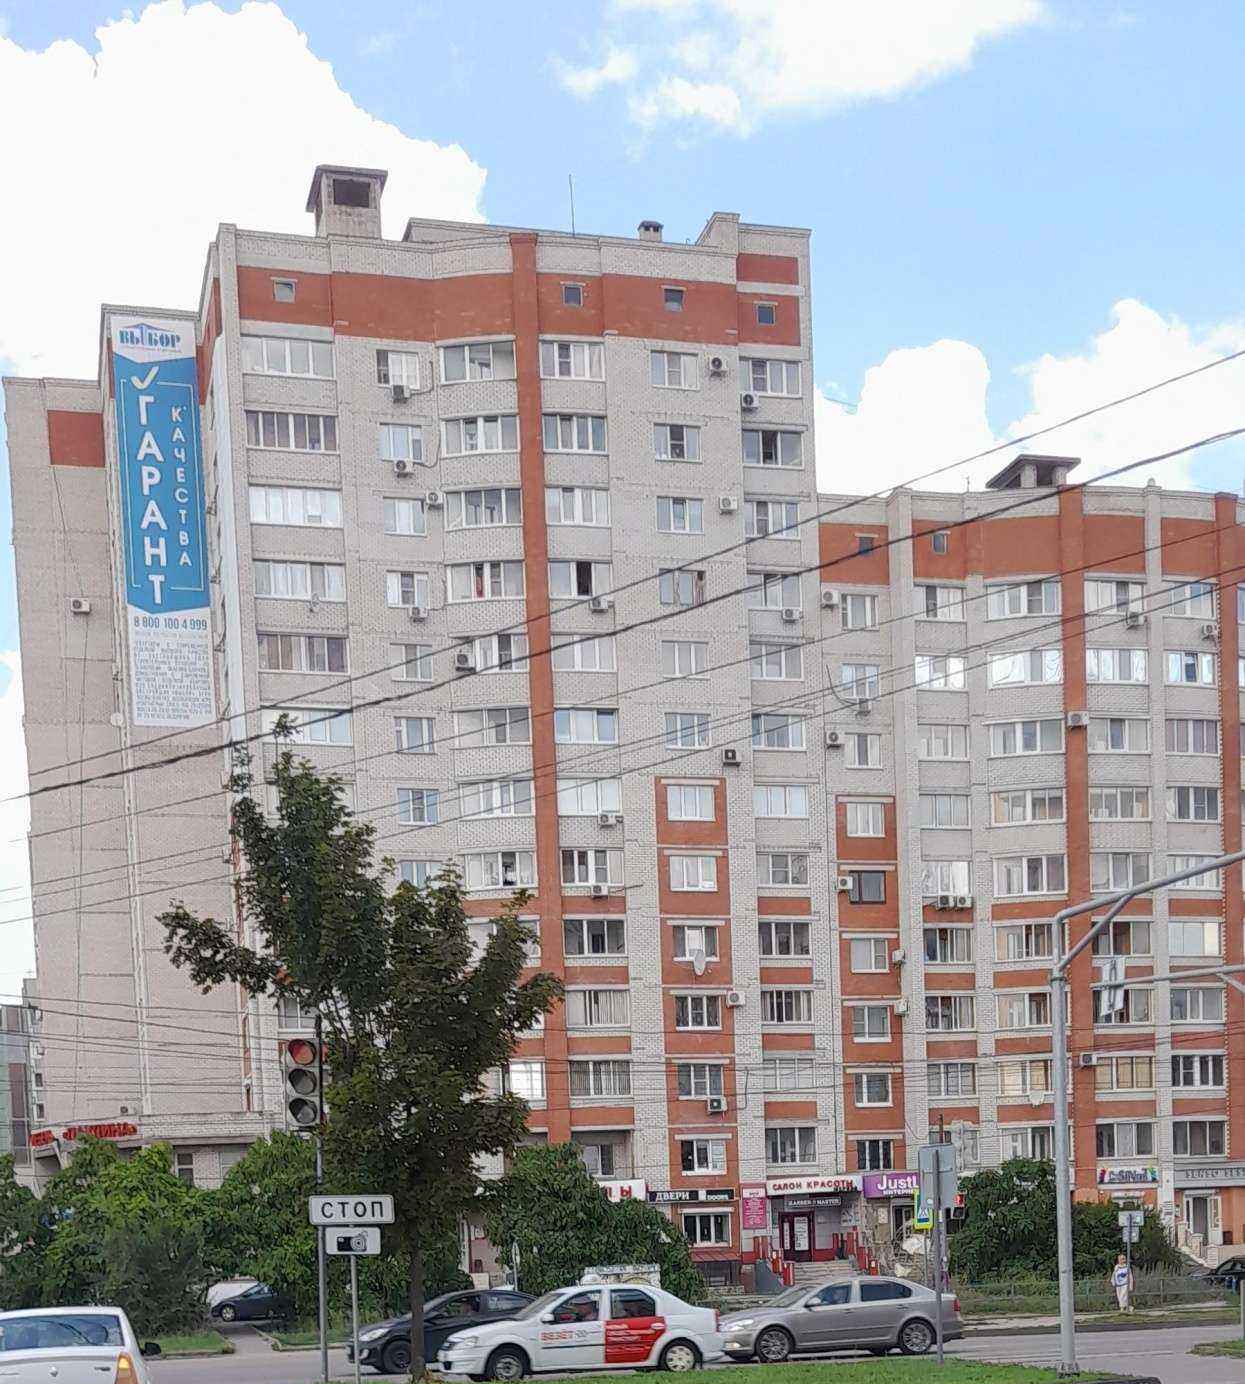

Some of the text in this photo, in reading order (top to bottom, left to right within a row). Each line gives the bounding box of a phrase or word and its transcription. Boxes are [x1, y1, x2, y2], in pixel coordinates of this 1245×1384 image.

[119, 327, 182, 348] ВЫБОР
[170, 405, 193, 568] КАЧЕСТВА
[135, 395, 169, 605] ГАРАНТ
[142, 616, 160, 629] 800
[163, 617, 180, 630] 100
[189, 618, 208, 631] 999
[772, 1182, 802, 1191] САЛОН
[655, 1191, 690, 1202] ДВЕРИ
[321, 1201, 384, 1219] СТОП
